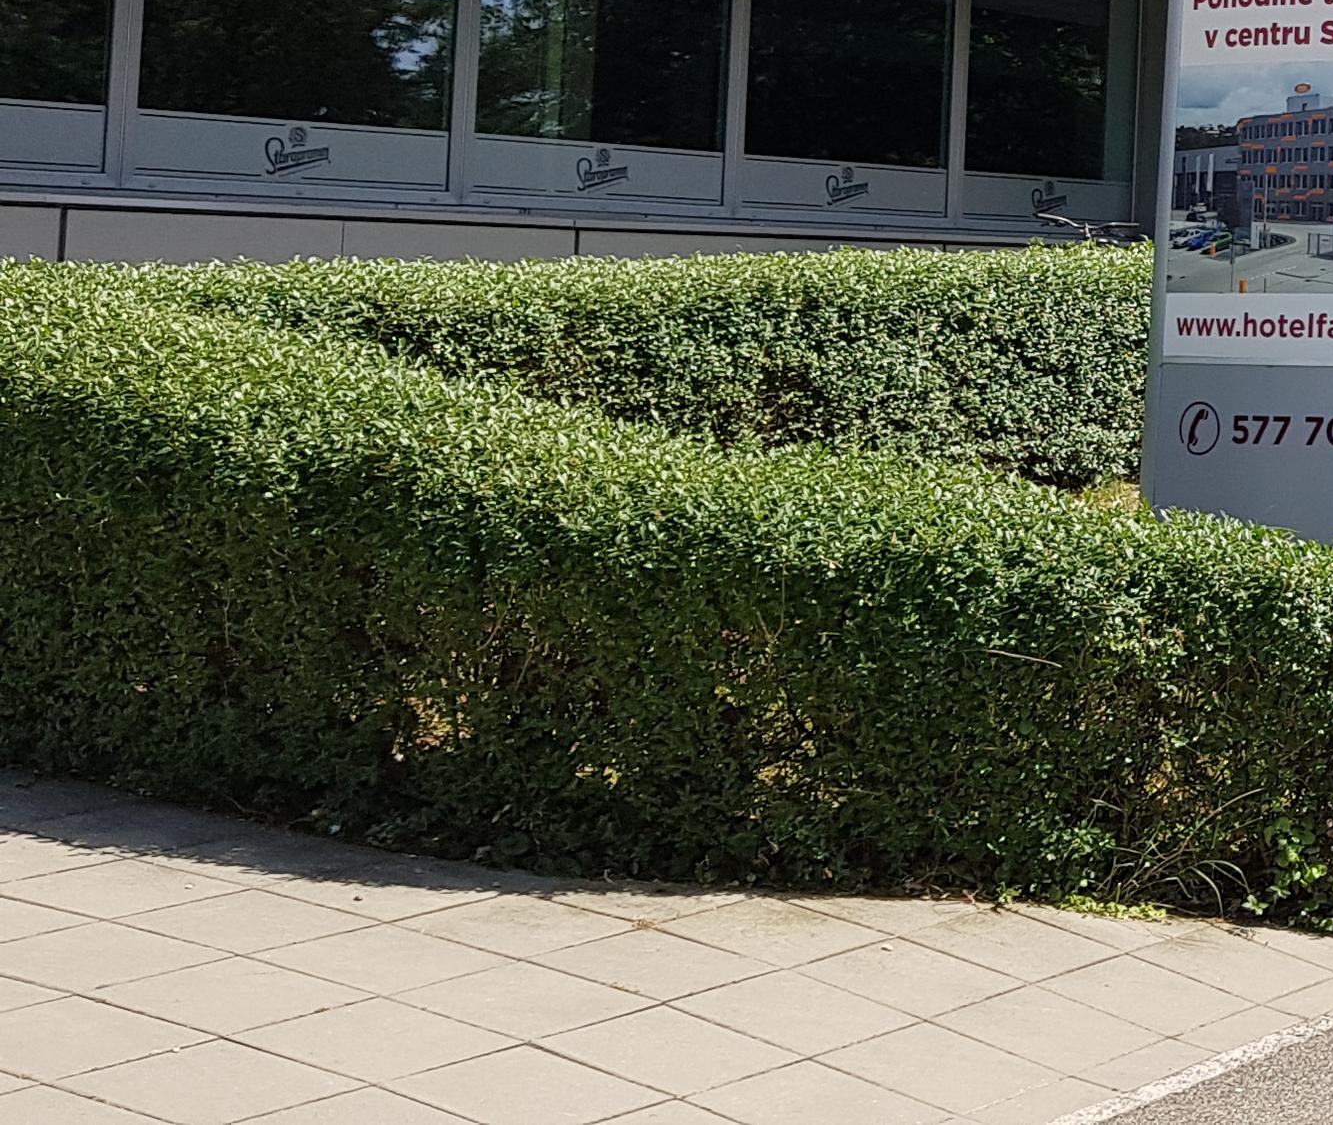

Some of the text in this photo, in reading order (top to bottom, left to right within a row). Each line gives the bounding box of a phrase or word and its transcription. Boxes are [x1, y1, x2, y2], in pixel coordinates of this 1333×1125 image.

[1204, 29, 1219, 48] v
[1225, 22, 1310, 48] centru
[1232, 415, 1291, 445] 577
